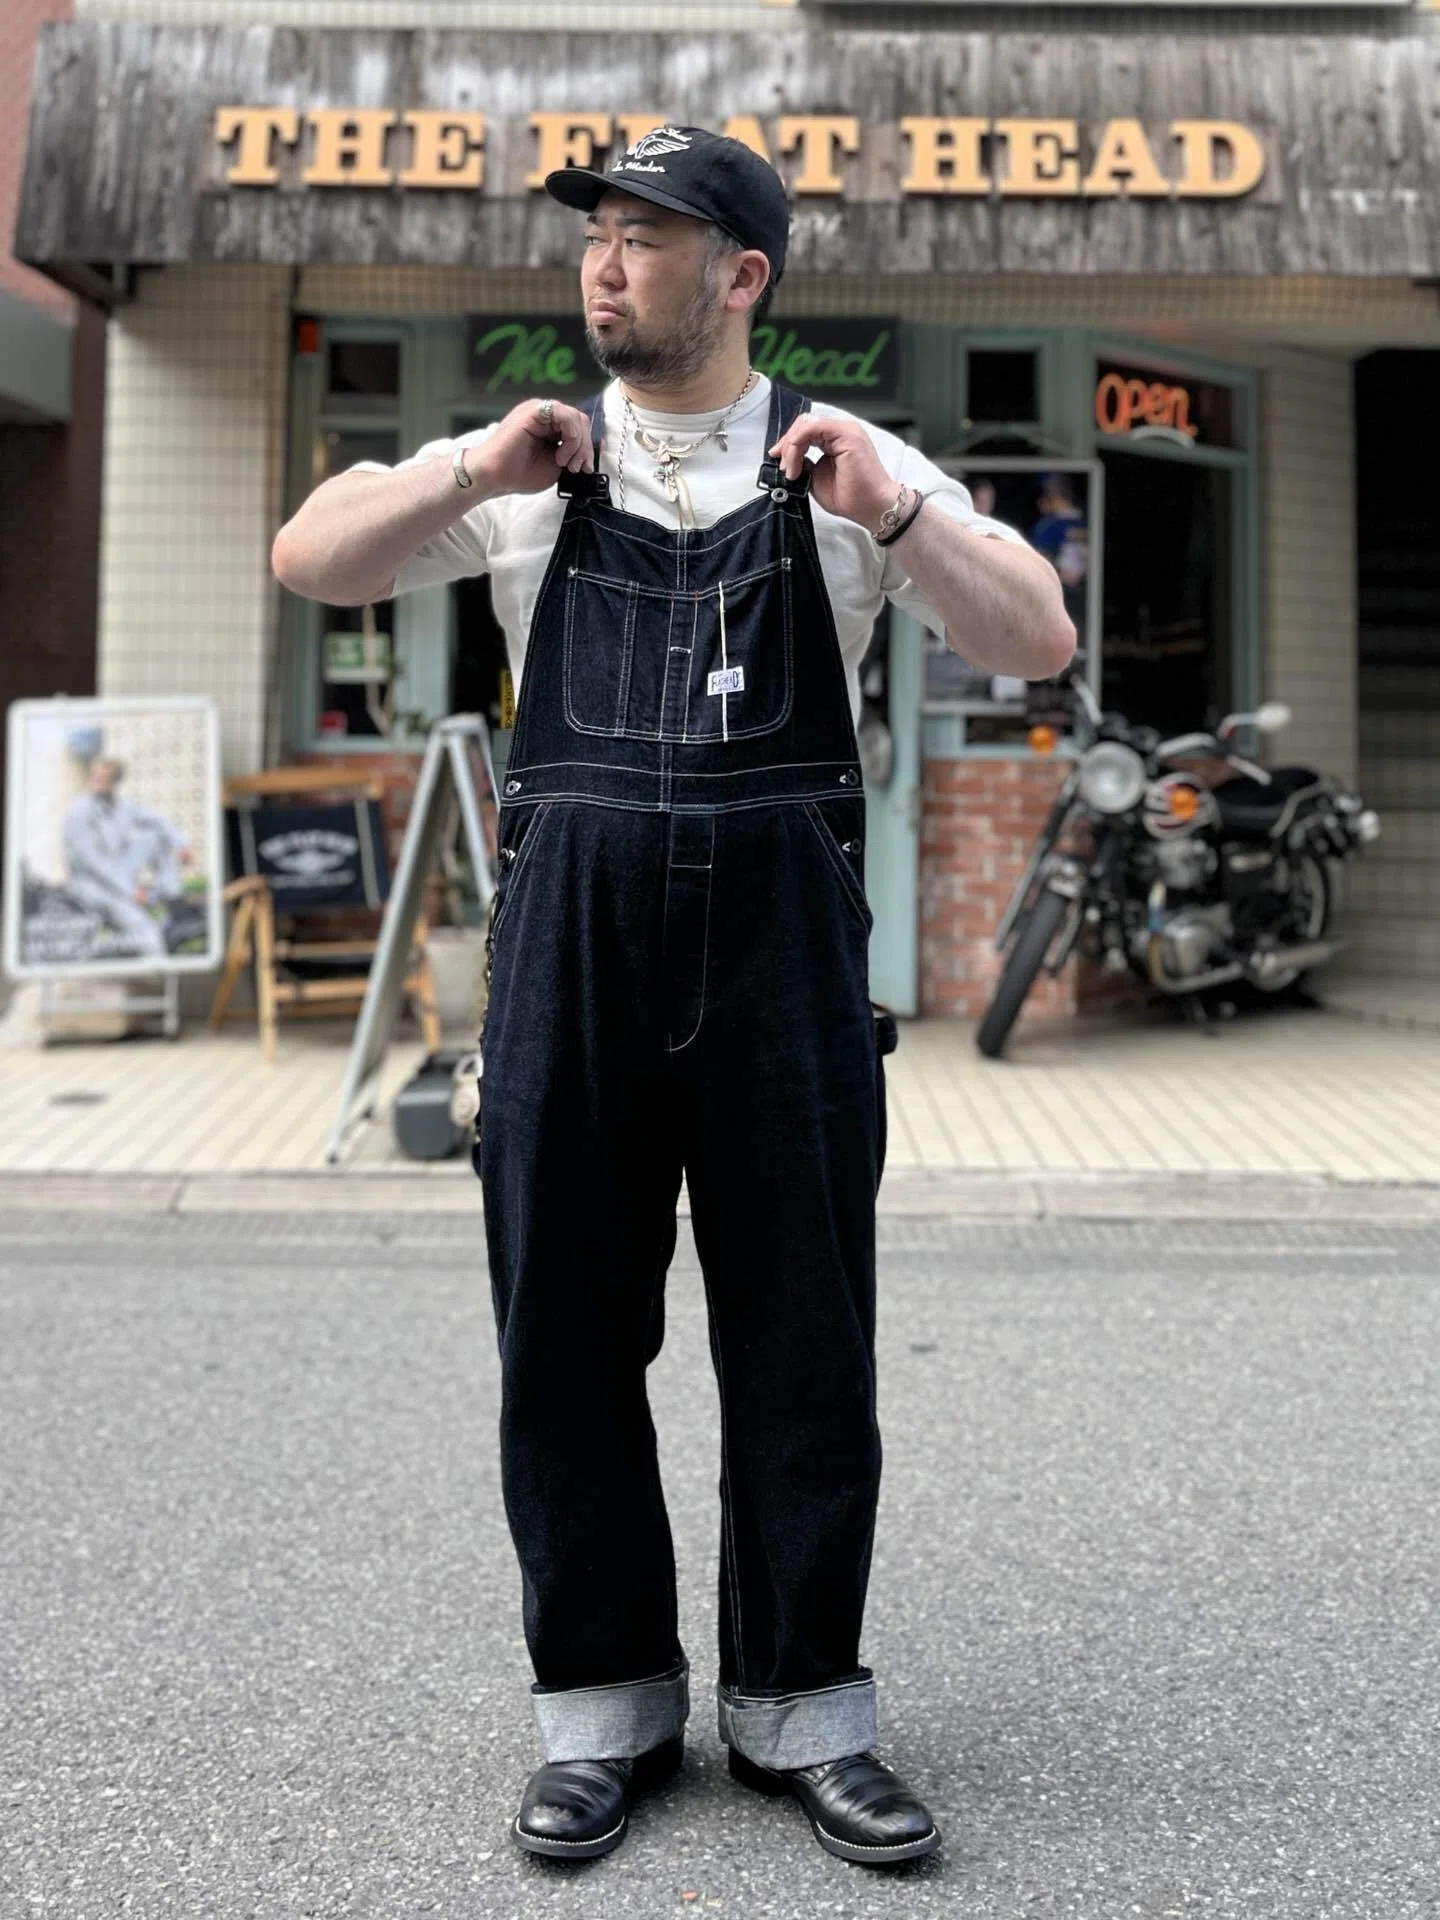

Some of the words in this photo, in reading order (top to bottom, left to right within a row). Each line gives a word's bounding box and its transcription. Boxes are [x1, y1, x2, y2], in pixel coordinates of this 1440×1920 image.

[215, 108, 486, 187] THE
[525, 112, 859, 192] FT
[900, 116, 1265, 198] HEAD
[476, 323, 577, 393] The
[752, 325, 892, 387] Head
